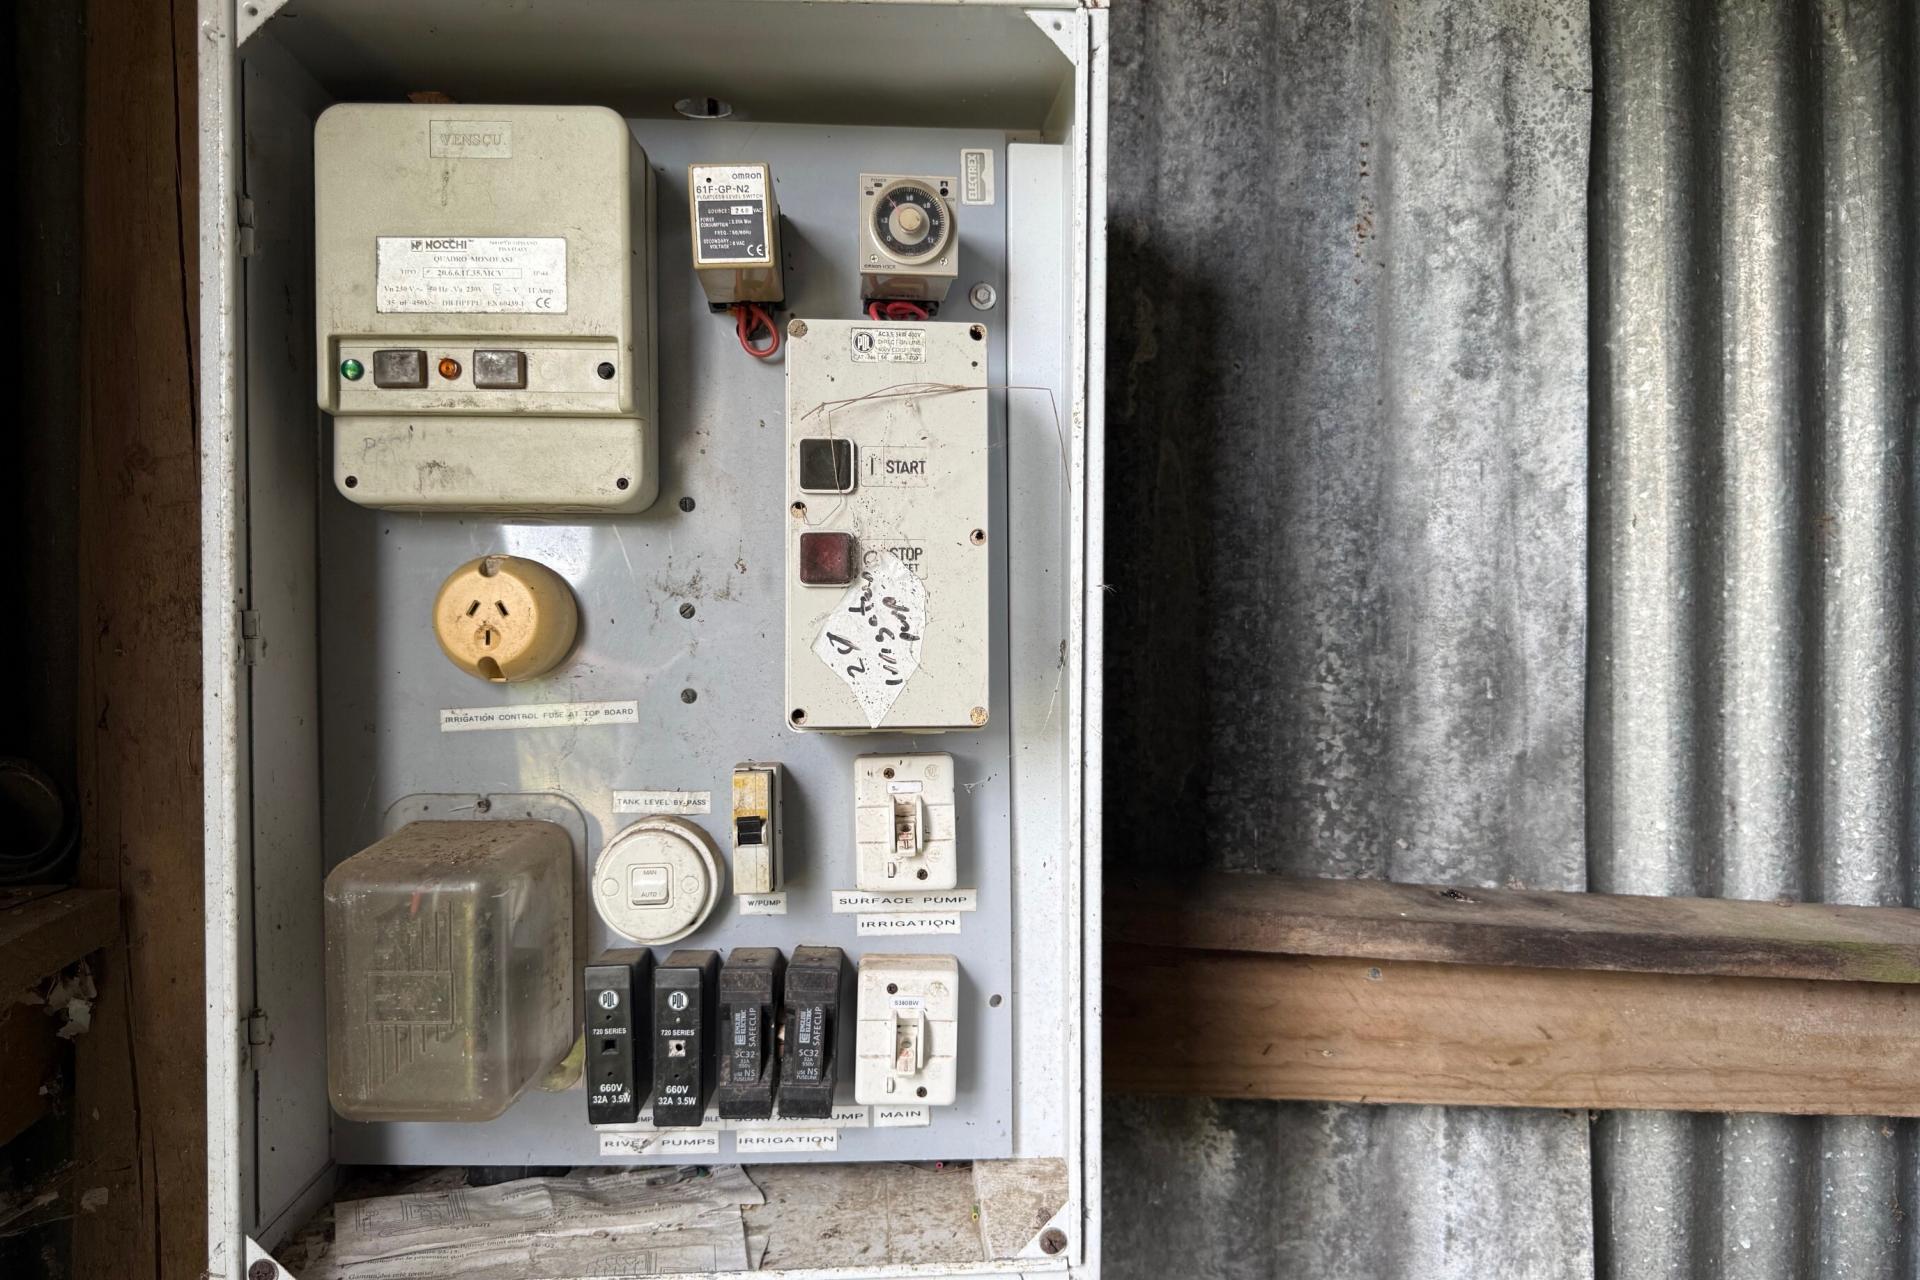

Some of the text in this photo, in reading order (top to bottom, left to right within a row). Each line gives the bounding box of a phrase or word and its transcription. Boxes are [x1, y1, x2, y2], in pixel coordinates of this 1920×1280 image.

[967, 154, 978, 200] ELECTREX
[696, 184, 750, 194] 61F-GP-N2
[425, 239, 467, 250] NOCCHI
[886, 460, 926, 475] START
[889, 547, 923, 560] STOP
[445, 715, 495, 724] IRRIGATION
[498, 713, 539, 721] CONTROL
[566, 710, 579, 718] AT
[604, 708, 634, 716] BOARD
[839, 896, 968, 905] SURFACE PUMP
[861, 919, 956, 928] IRRIGATION
[602, 991, 617, 1008] PDL
[672, 992, 685, 1009] PDL
[748, 1007, 757, 1047] SAFECLIP
[812, 1006, 822, 1046] SAFECLIP
[604, 1027, 627, 1035] SERIES
[735, 1050, 755, 1058] SC32
[798, 1049, 819, 1057] SC32
[744, 1069, 755, 1078] NS
[807, 1067, 818, 1076] NS
[600, 1083, 623, 1092] 660V
[665, 1085, 689, 1094] 660V
[593, 1094, 631, 1104] 32A 3.5W
[658, 1096, 697, 1105] 32A 3.5W
[880, 1110, 921, 1119] MAIN
[662, 1138, 716, 1146] PUMPS
[738, 1135, 834, 1145] IRRIGATION
